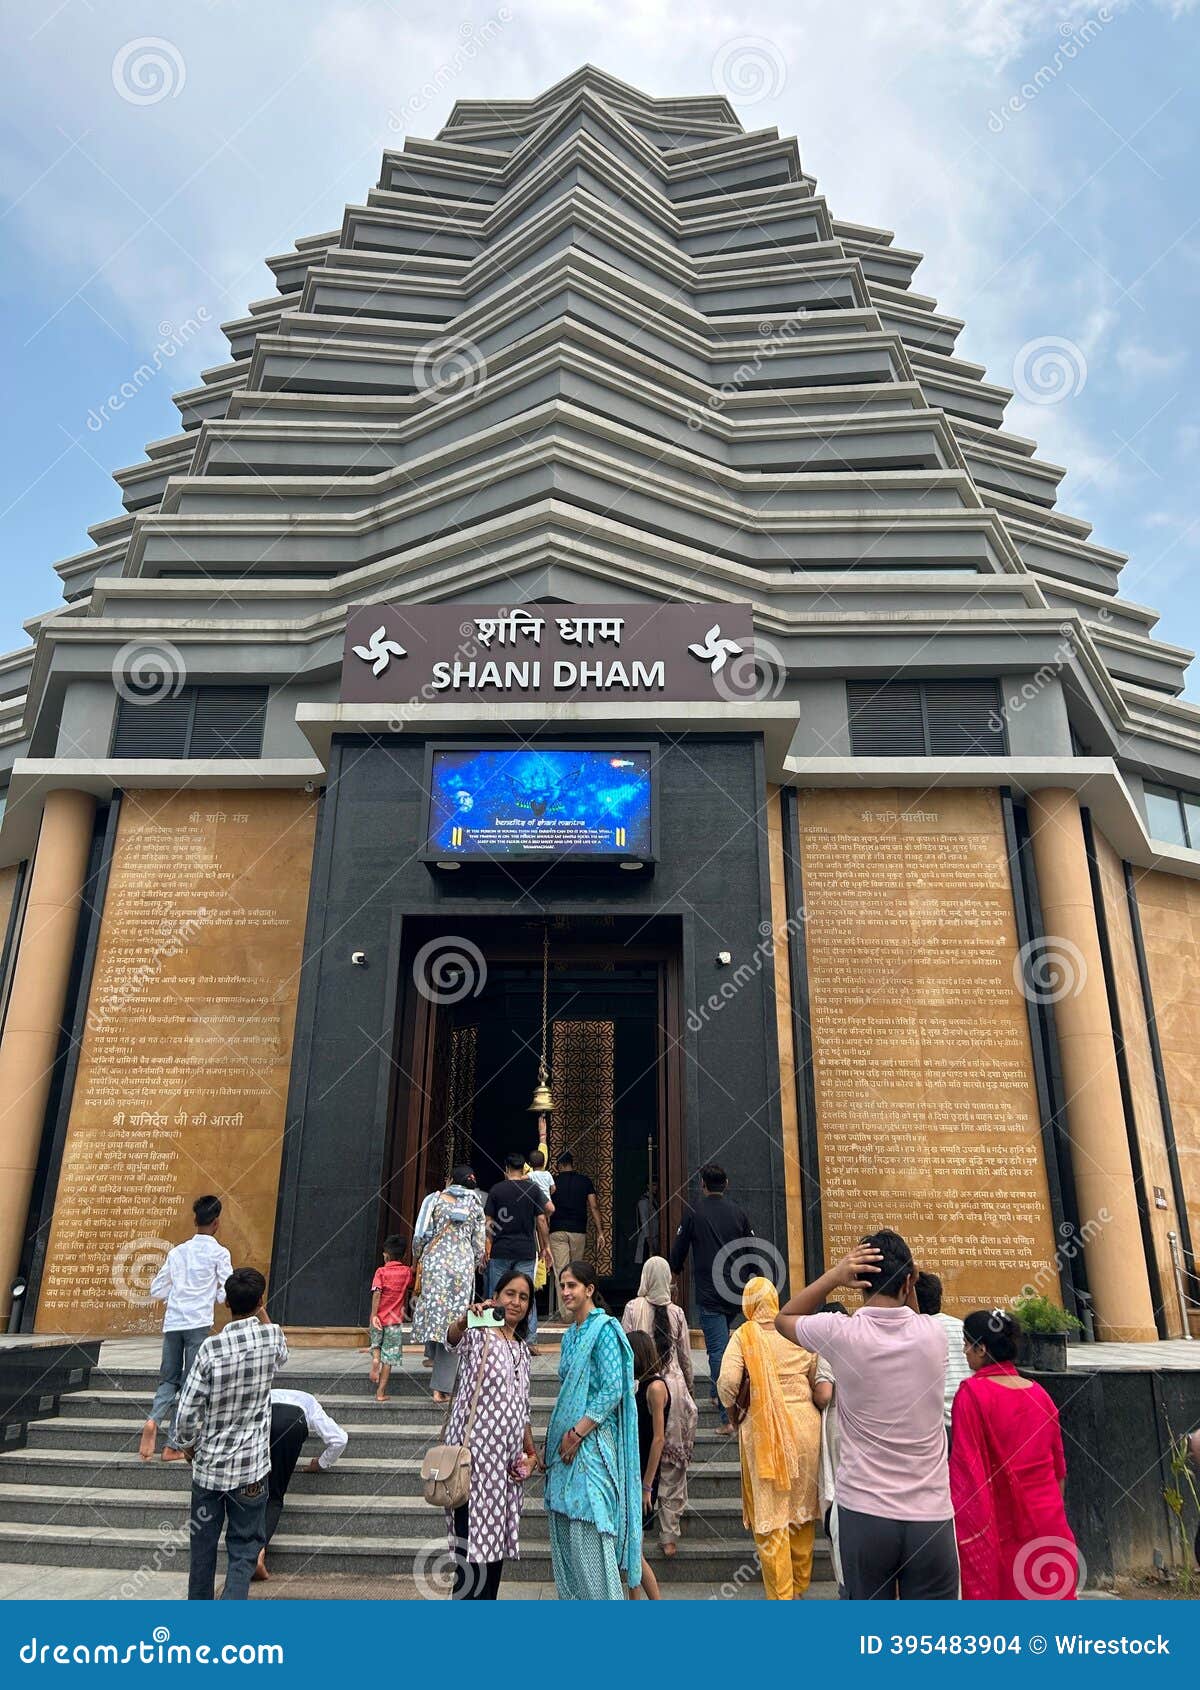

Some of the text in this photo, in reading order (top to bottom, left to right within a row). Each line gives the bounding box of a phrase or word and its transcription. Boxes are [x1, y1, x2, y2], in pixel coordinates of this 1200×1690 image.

[474, 609, 625, 647] शनि धाम
[432, 660, 665, 689] SHANI DHAM
[861, 811, 938, 823] श्री शनि चालीसा
[112, 1112, 244, 1127] श्री शनिदेव जी की आरती
